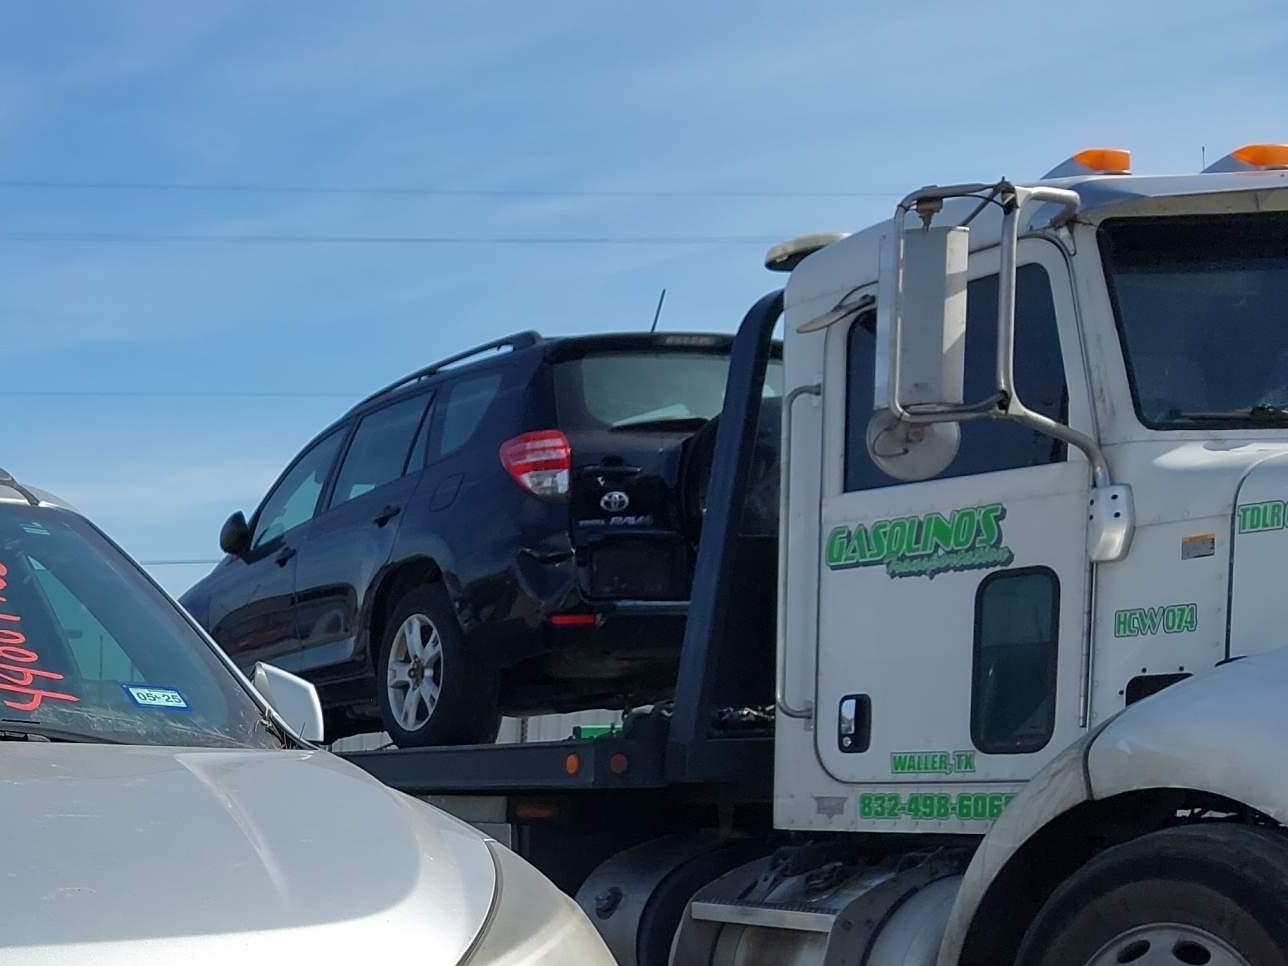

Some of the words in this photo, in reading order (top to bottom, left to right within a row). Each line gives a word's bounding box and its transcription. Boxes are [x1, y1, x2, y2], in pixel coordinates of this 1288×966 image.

[826, 504, 1007, 570] GASOLINO'S
[1164, 603, 1197, 633] 074
[891, 752, 951, 774] WALLER,
[952, 751, 976, 772] TX
[860, 793, 1016, 820] 832-498-606
